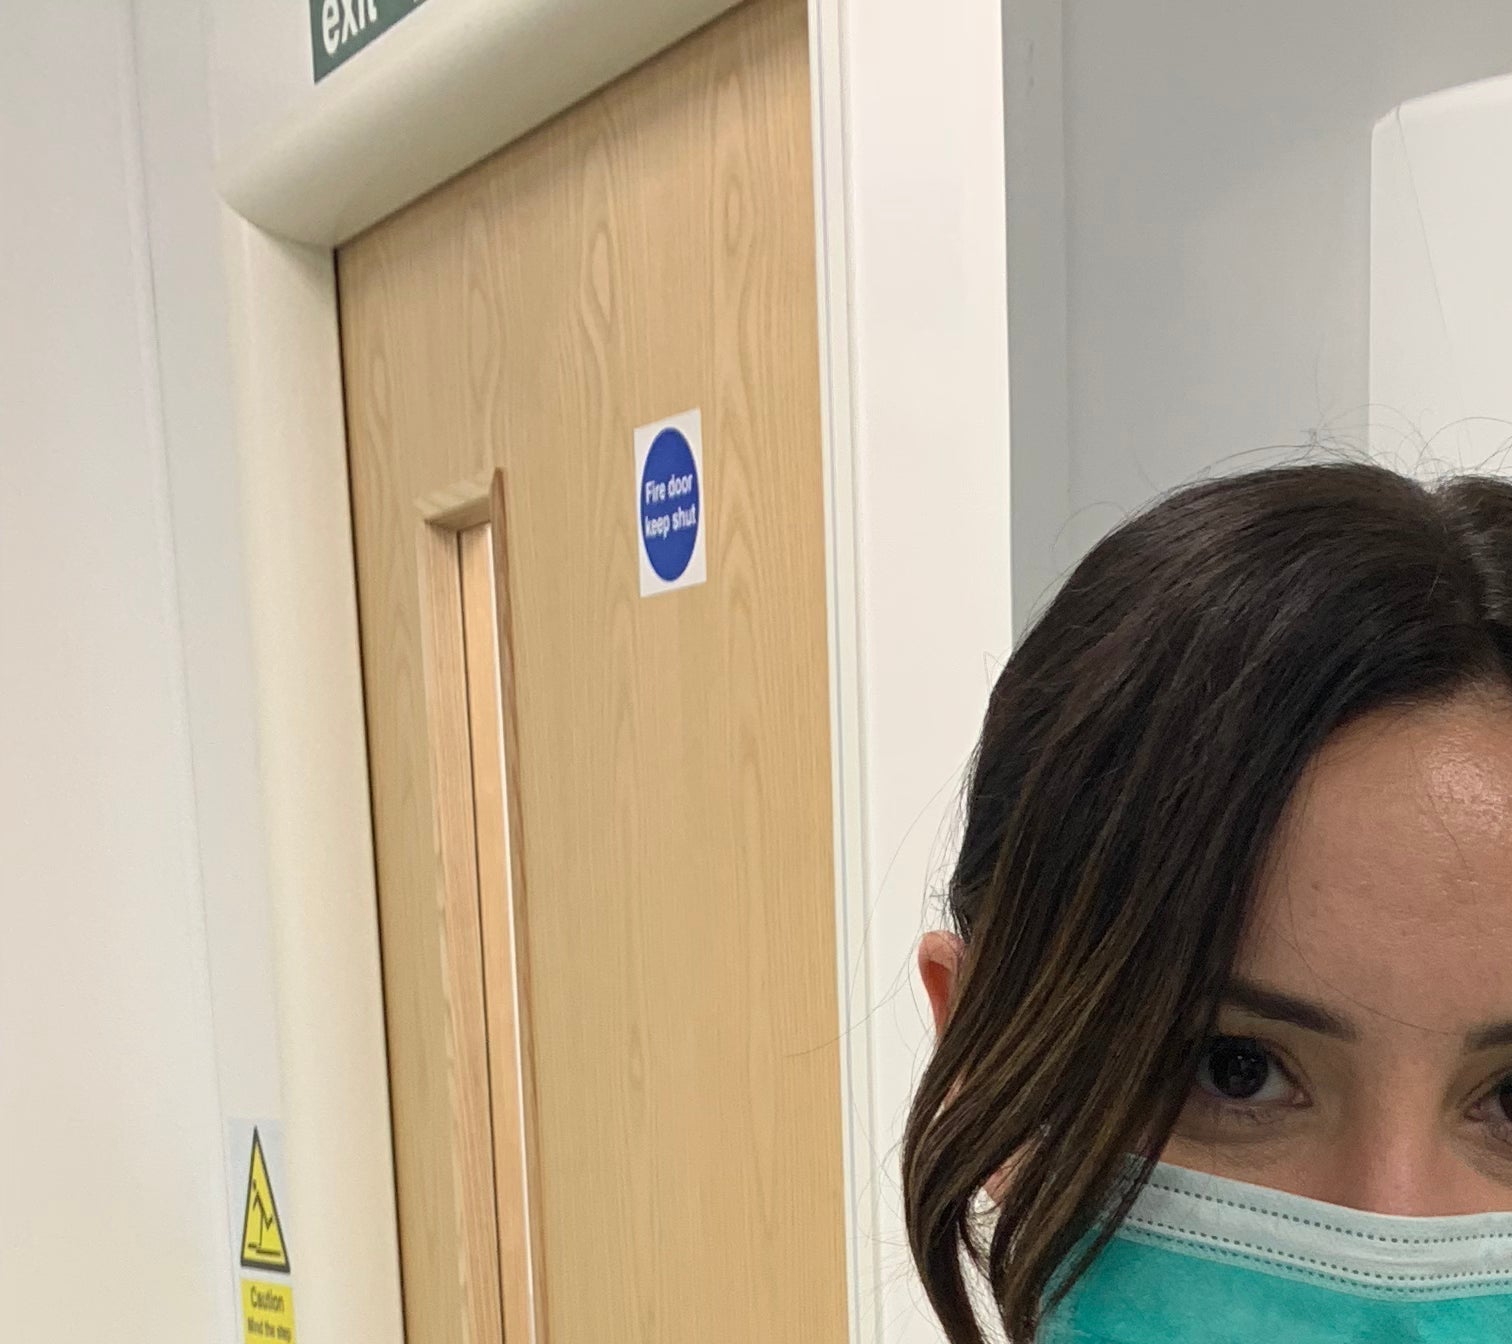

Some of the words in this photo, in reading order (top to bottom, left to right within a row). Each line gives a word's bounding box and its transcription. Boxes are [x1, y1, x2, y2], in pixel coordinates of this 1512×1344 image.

[645, 480, 666, 505] Fire
[667, 473, 693, 498] door
[645, 514, 670, 540] keep
[672, 504, 696, 531] shut
[250, 1285, 285, 1313] Caution
